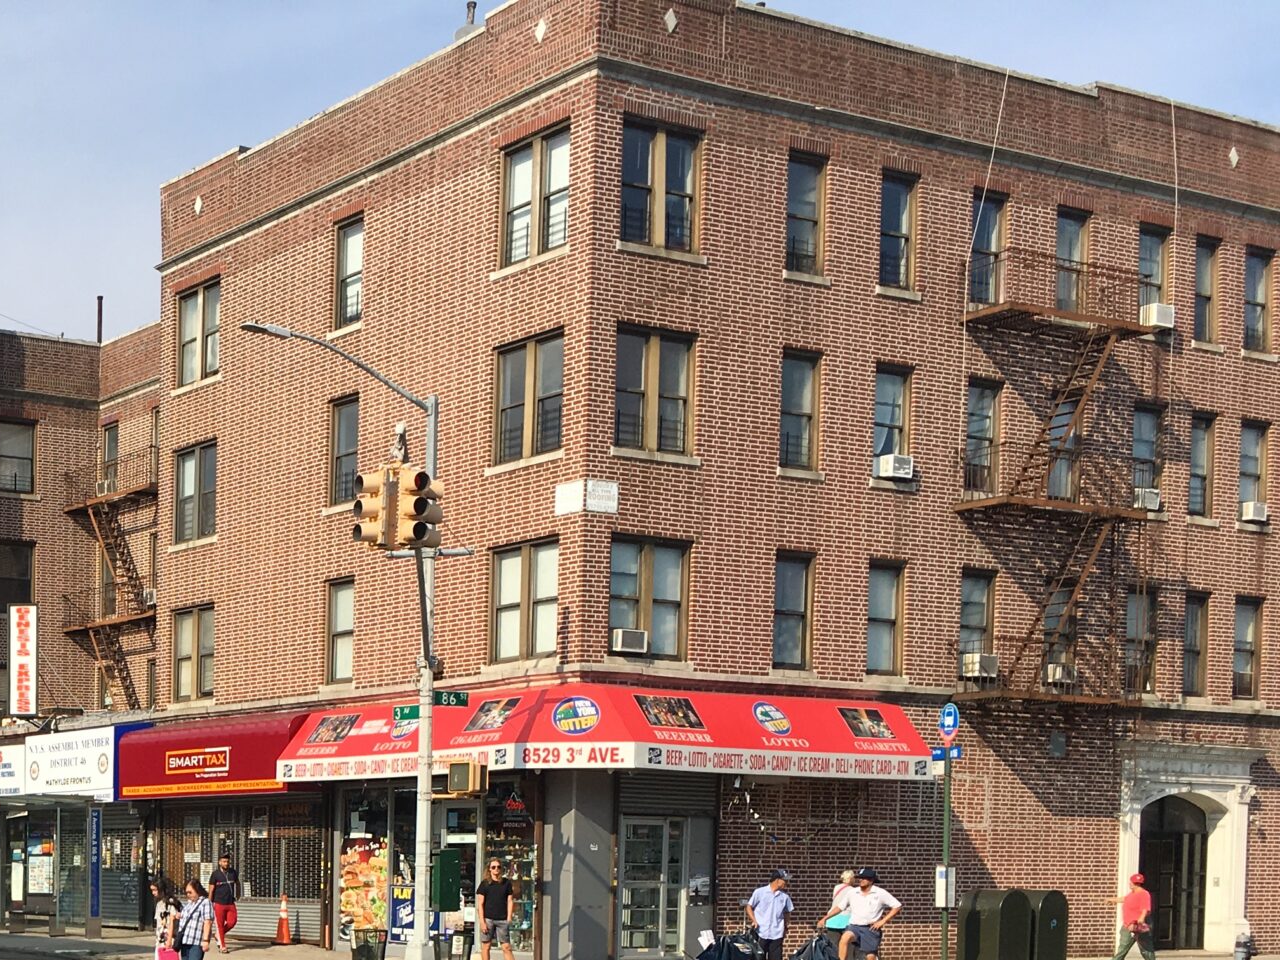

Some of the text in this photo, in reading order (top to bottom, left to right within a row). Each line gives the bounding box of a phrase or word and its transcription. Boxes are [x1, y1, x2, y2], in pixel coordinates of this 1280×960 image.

[16, 607, 30, 712] GENESIS EXPRESS
[441, 693, 457, 705] 86
[395, 707, 401, 720] 3
[576, 706, 597, 717] YORK
[556, 715, 598, 731] LOTTERY
[48, 740, 80, 752] ASSEMBLY
[81, 737, 110, 749] MEMBER
[450, 732, 503, 745] CIGARETTE
[762, 736, 809, 748] LOTTO
[373, 741, 412, 752] LOTTO
[854, 741, 911, 752] CIGARETTE
[169, 753, 226, 768] SMARTTAX
[522, 747, 560, 764] 8529
[566, 748, 583, 763] 3rd
[587, 747, 625, 764] AVE.
[49, 757, 87, 768] DISTRICT 46
[354, 760, 367, 776] SODA
[370, 759, 387, 774] CANDY
[392, 758, 400, 773] ICE
[666, 749, 683, 766] BEER
[688, 751, 707, 768] LOTTO
[712, 752, 743, 770] CIGARETTE
[749, 755, 766, 771] SODA
[771, 756, 792, 772] CANDY
[797, 757, 807, 772] ICE
[808, 757, 830, 773] CREAM
[836, 758, 849, 774] DELI
[854, 759, 874, 775] PHONE
[876, 760, 892, 775] CARD
[897, 760, 909, 776] ATM
[45, 776, 92, 786] MATHYLDE FRONTUS
[394, 888, 413, 900] PLAY
